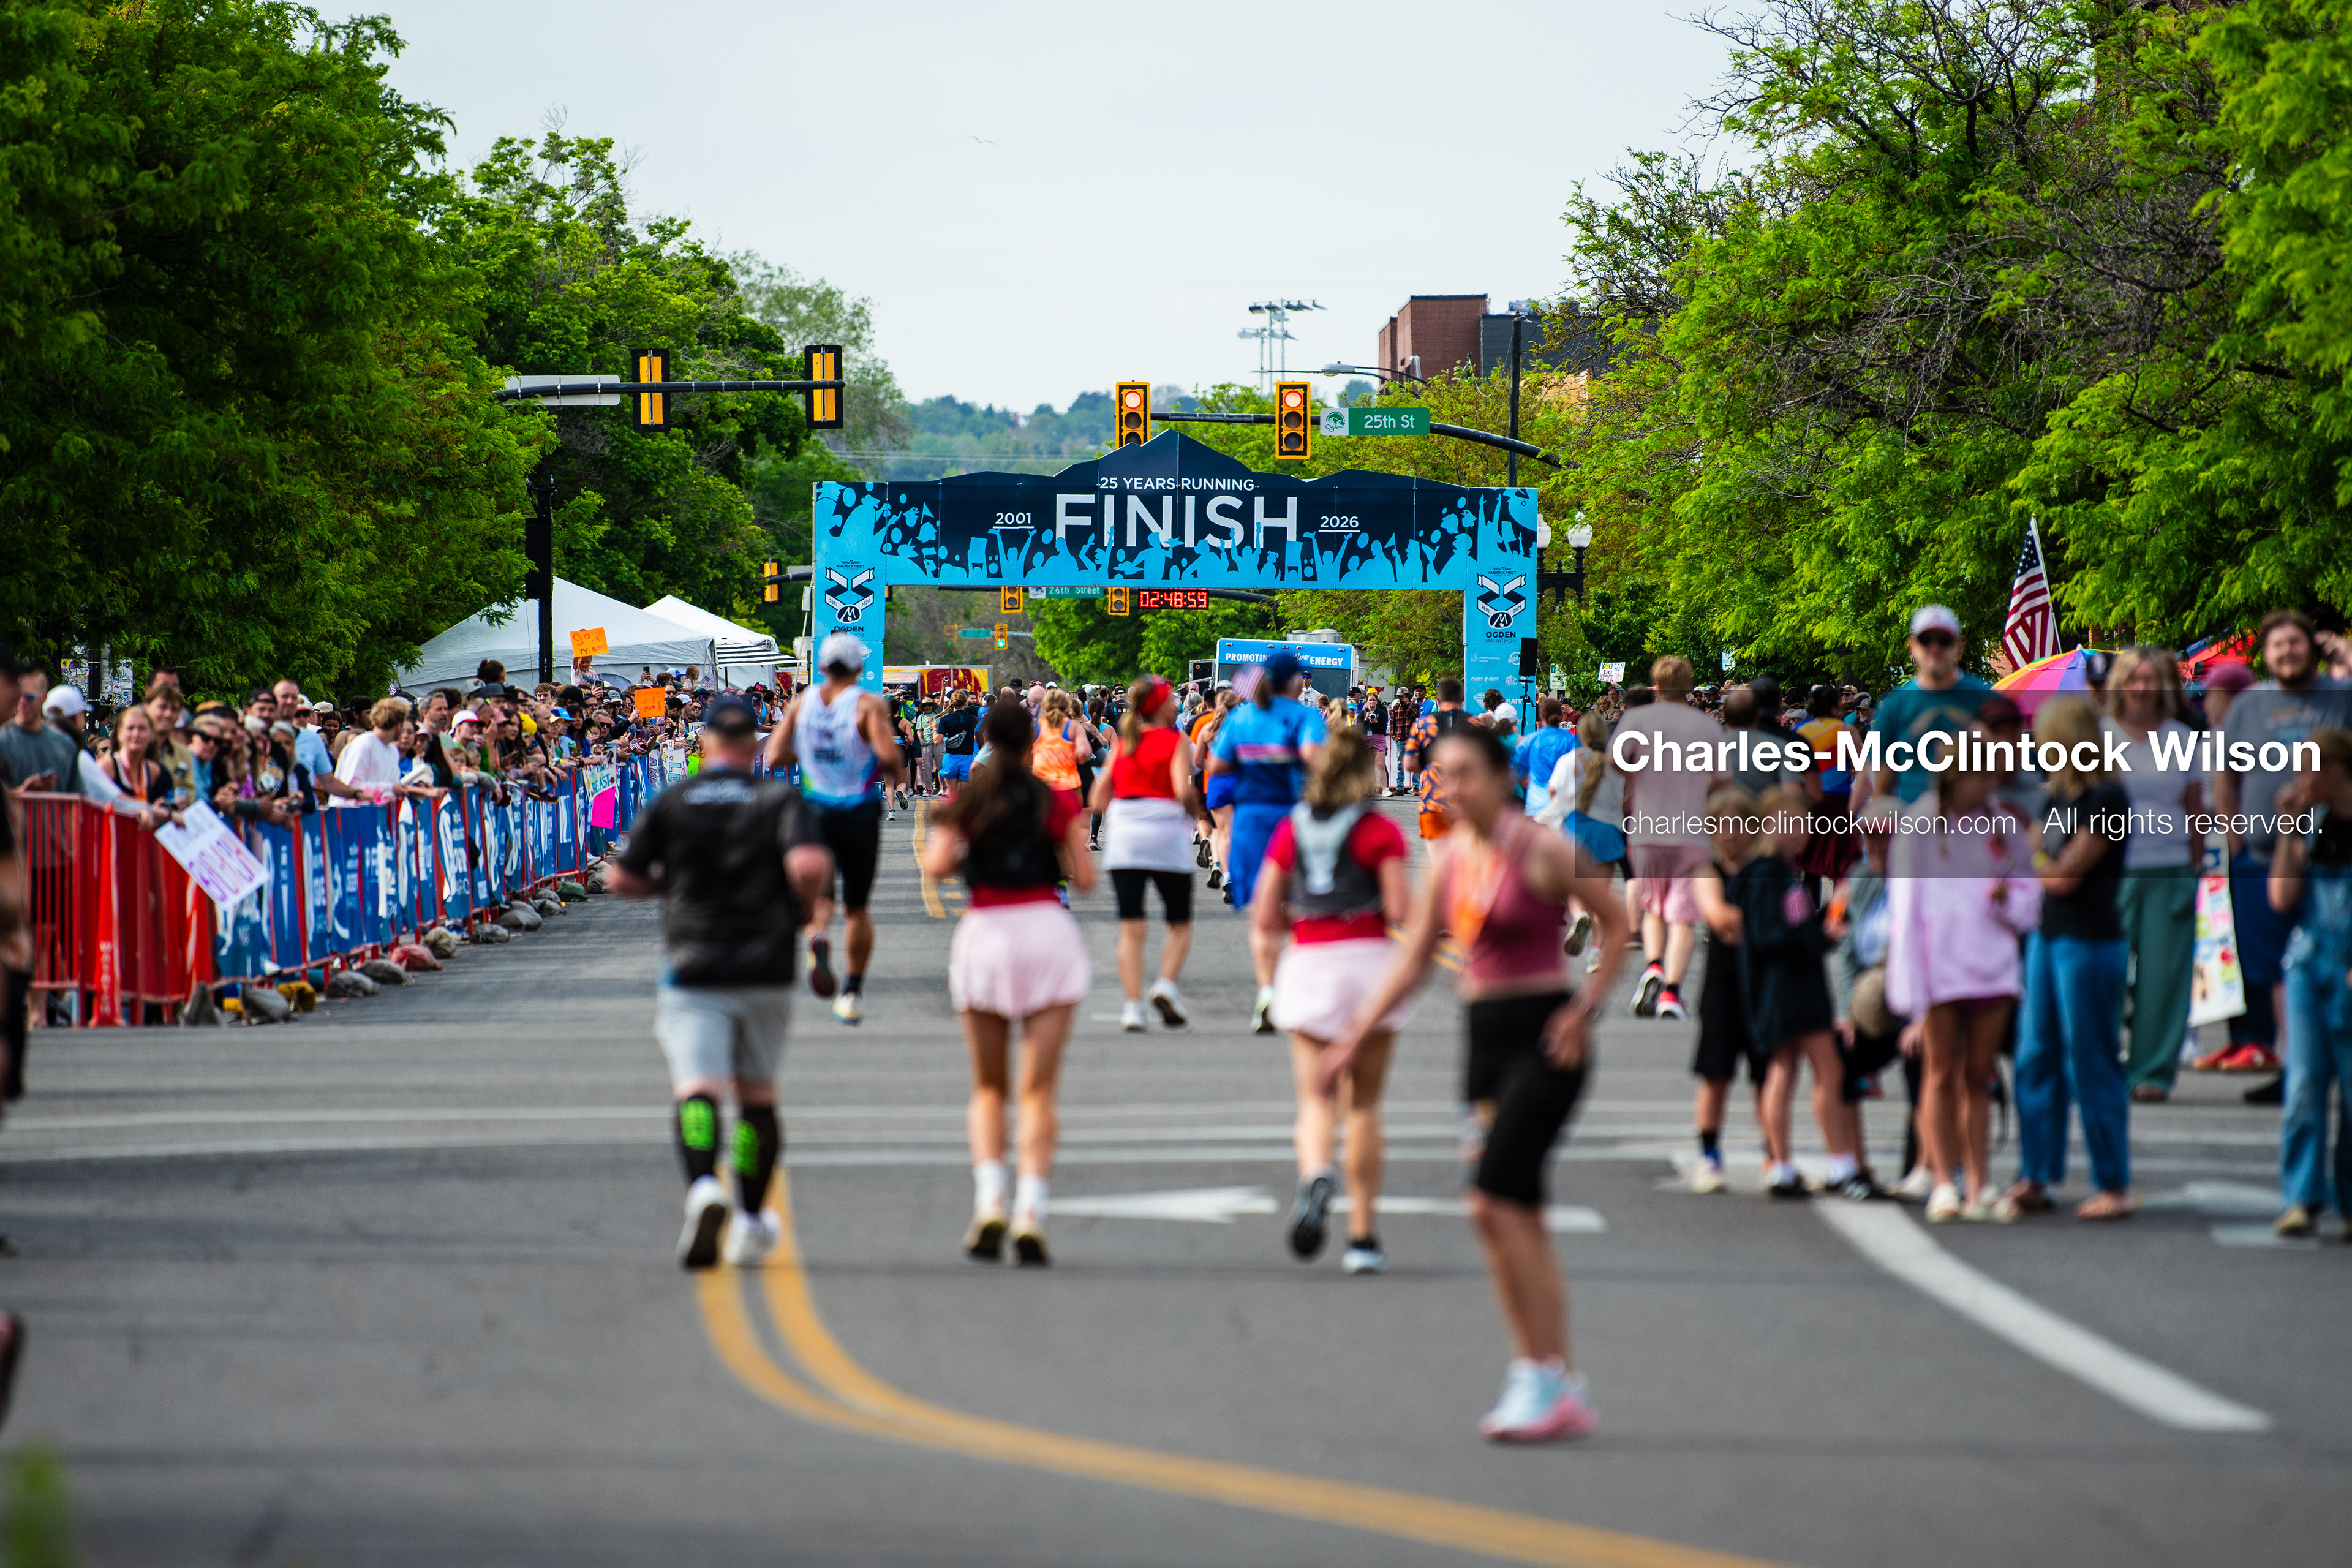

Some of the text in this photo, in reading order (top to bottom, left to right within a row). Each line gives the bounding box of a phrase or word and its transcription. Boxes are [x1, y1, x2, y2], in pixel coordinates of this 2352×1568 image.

[1325, 424, 1346, 432] Ogden
[1364, 415, 1415, 428] 25th St
[1099, 477, 1255, 491] 25 YEARS RUNNING
[995, 512, 1031, 525] 2001
[1055, 494, 1297, 549] FINISH
[1320, 516, 1359, 529] 2026
[1049, 586, 1101, 595] 26th Street
[829, 598, 838, 608] 2001
[1139, 591, 1207, 608] 02:48:59
[1481, 605, 1490, 613] 2001
[573, 632, 590, 646] go
[1310, 656, 1343, 666] ENERGY
[591, 773, 610, 794] BEAST
